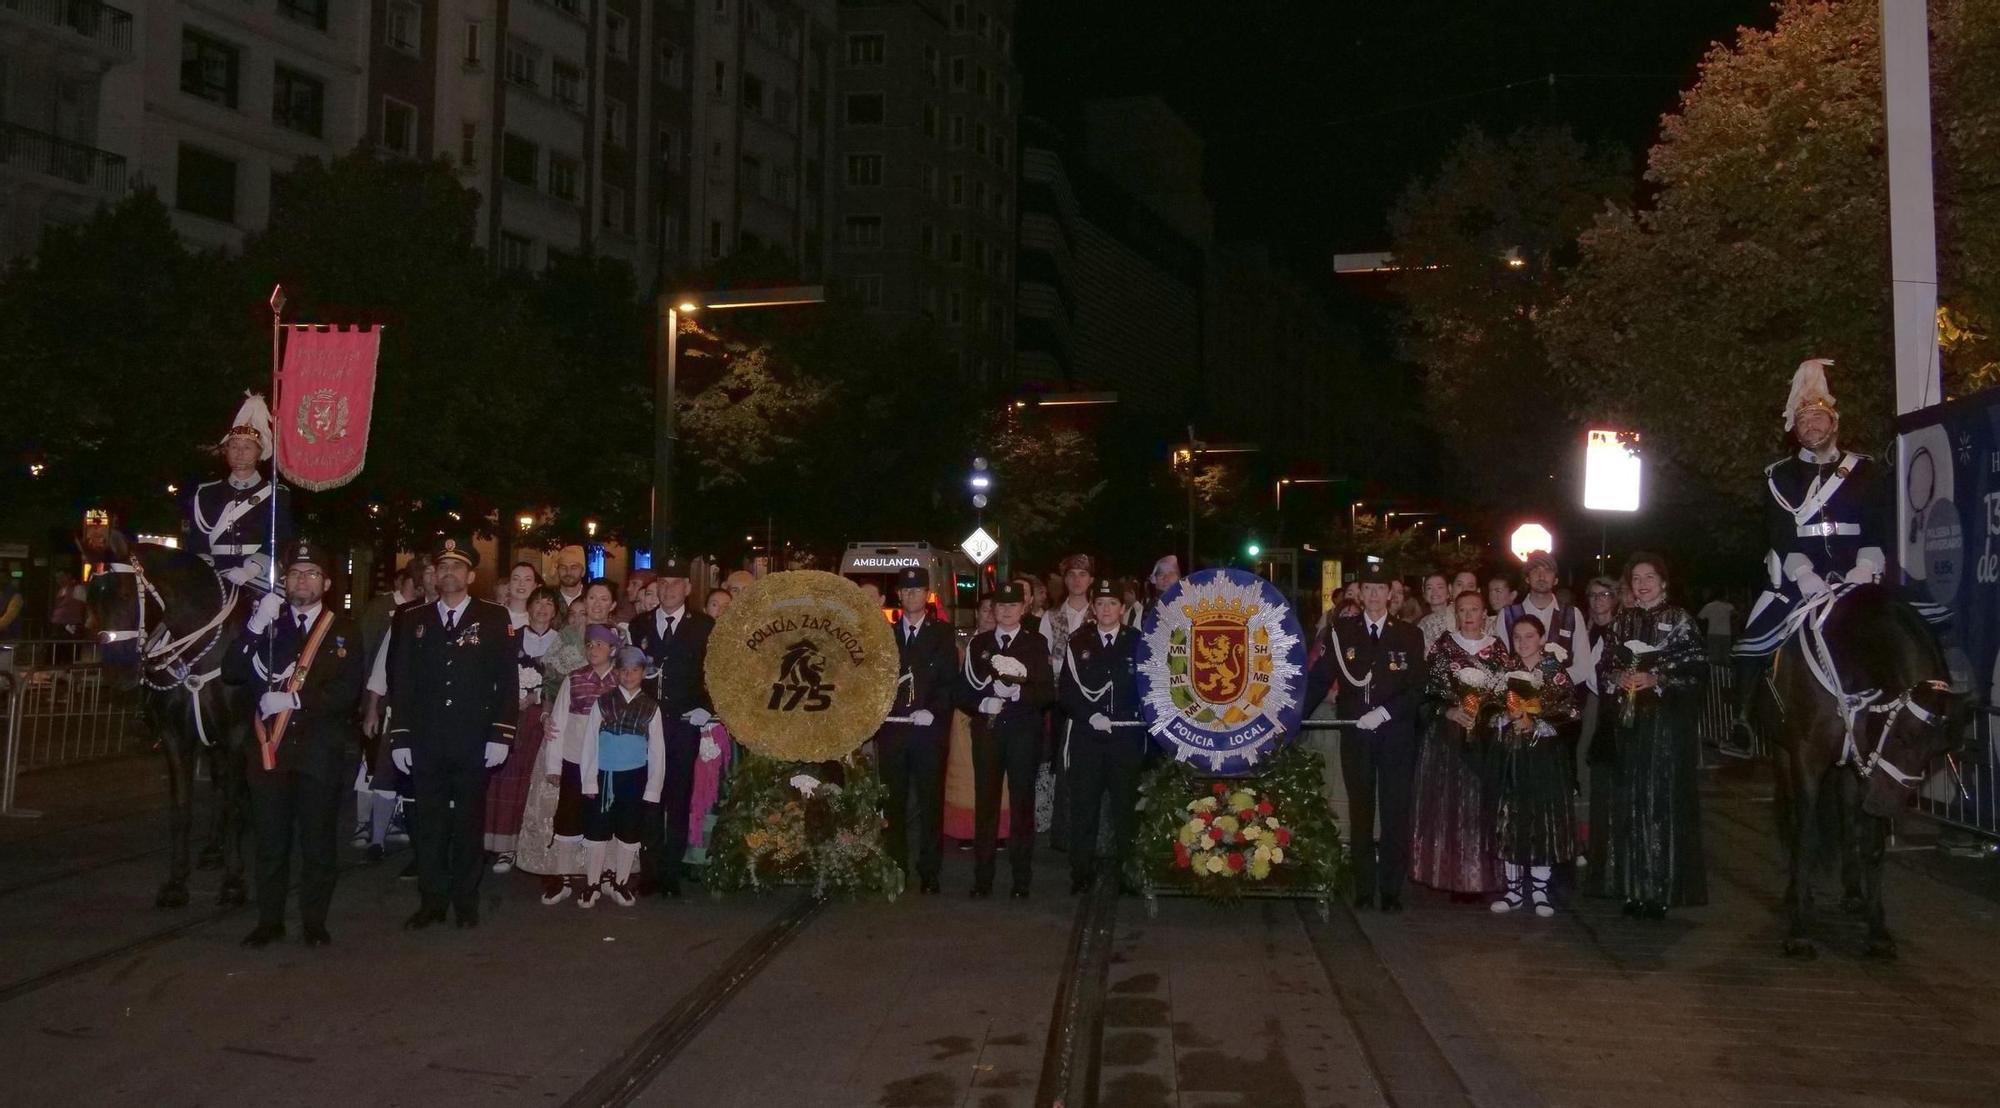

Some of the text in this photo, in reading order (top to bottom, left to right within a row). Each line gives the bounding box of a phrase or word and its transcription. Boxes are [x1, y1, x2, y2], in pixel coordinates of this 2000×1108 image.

[853, 558, 920, 567] AMBULANCIA
[802, 614, 865, 667] ZARAGOZA
[1170, 645, 1187, 655] MN
[1254, 645, 1268, 654] SH
[1170, 675, 1185, 685] ML
[1253, 672, 1270, 683] MB
[768, 683, 835, 712] 175
[1184, 702, 1202, 718] MH
[1173, 722, 1266, 747] POLICIA LOCAL
